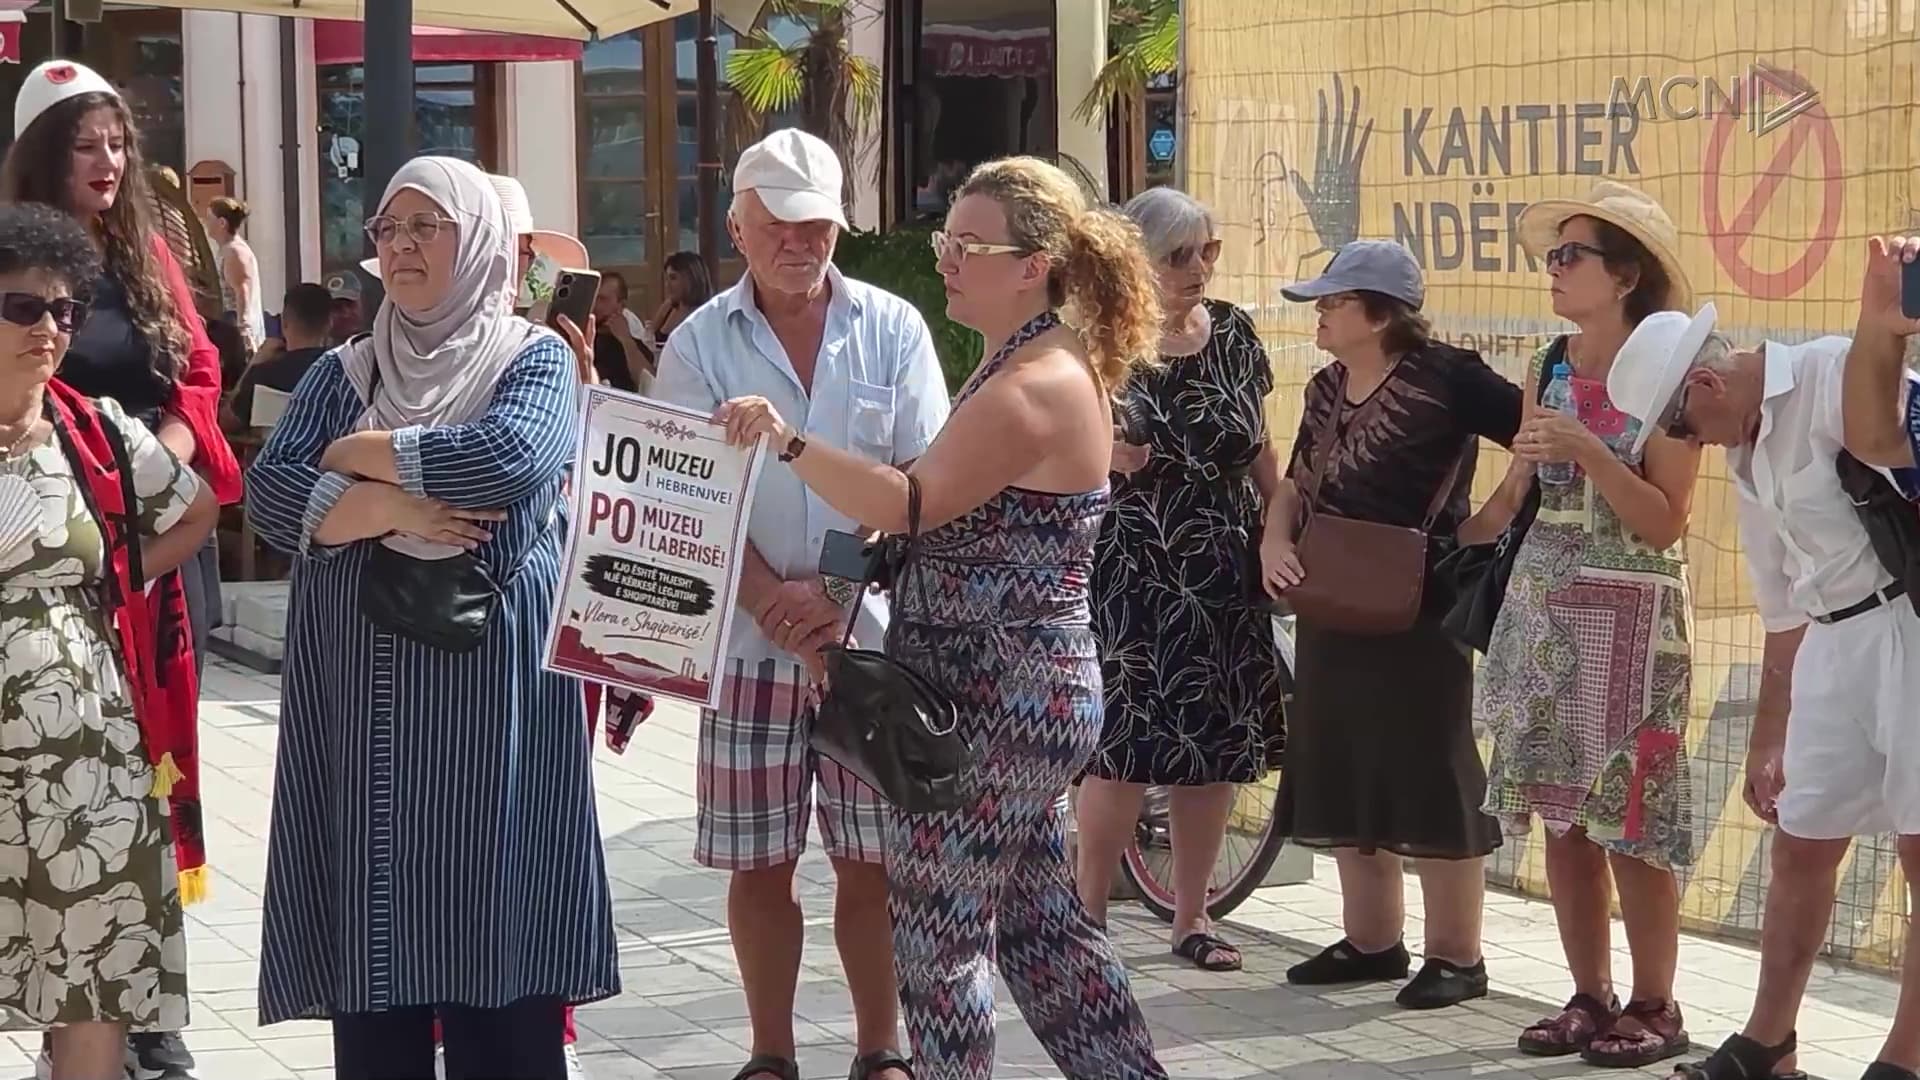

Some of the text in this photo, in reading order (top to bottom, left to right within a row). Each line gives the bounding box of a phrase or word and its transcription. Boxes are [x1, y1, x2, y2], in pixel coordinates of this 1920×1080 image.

[1403, 103, 1641, 176] KANTIER
[1393, 182, 1540, 272] NDËR
[592, 432, 641, 483] JO
[647, 445, 715, 480] MUZEU
[656, 477, 733, 504] HEBRENJVE!
[588, 490, 636, 544] PO
[642, 504, 703, 539] MUZEU
[648, 532, 726, 569] LABERISË!
[621, 616, 629, 627] e
